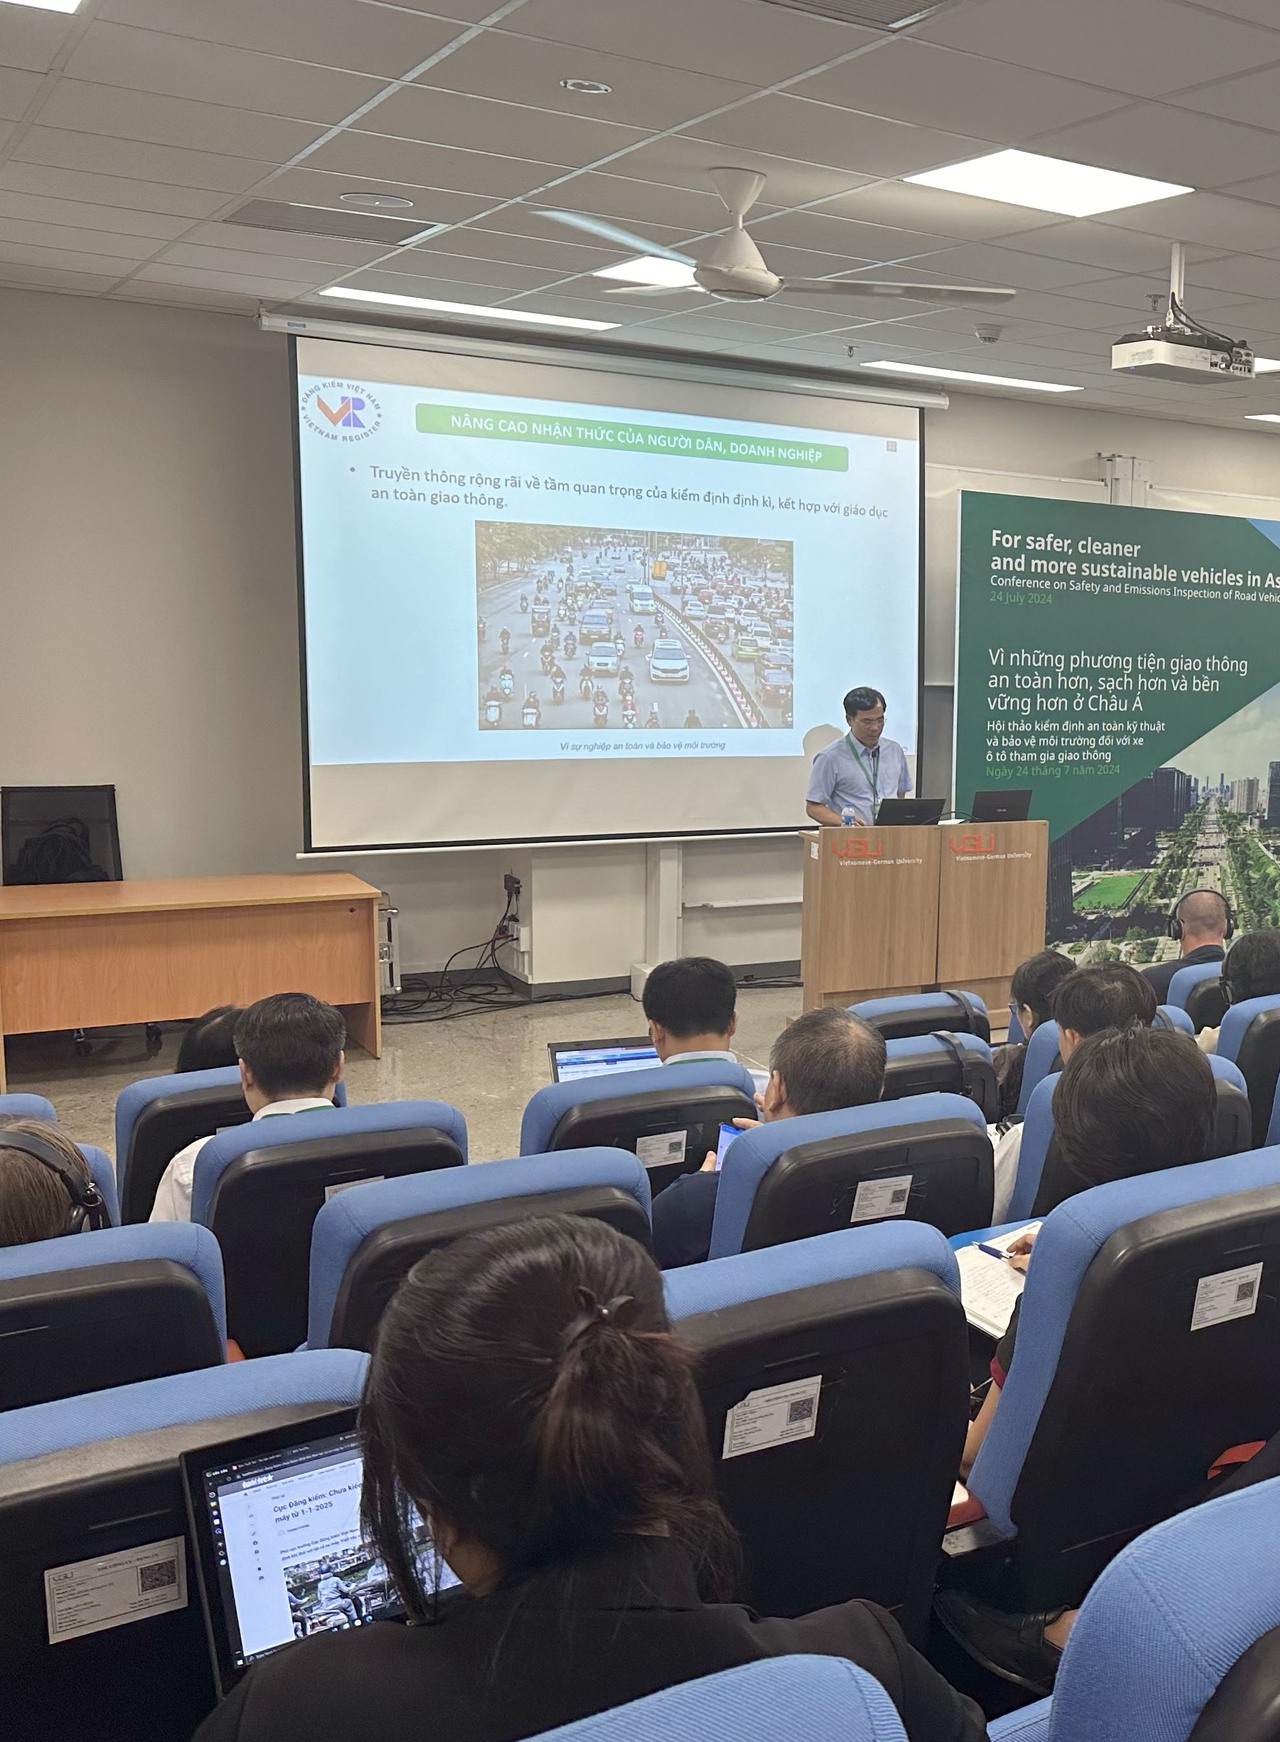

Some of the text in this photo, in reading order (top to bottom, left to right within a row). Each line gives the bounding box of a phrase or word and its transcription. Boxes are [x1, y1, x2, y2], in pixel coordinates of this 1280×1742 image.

[366, 393, 381, 410] NAM
[303, 414, 381, 442] VIETNAM REGISTER
[451, 413, 822, 464] NÂNG CAO NHẬN THỨC CỦA NGƯỜI DÂN, DOANH NGHIỆP
[370, 465, 420, 483] Truyền
[424, 469, 466, 487] thông
[470, 473, 501, 490] rộng
[505, 475, 521, 489] rãi
[525, 475, 541, 490] về
[544, 477, 570, 492] tầm
[573, 482, 606, 496] quan
[609, 484, 643, 501] trọng
[646, 485, 668, 500] của
[671, 486, 700, 503] kiểm
[703, 491, 730, 507] định
[733, 493, 759, 508] định
[778, 496, 796, 510] kết
[798, 498, 821, 514] hợp
[824, 501, 841, 515] với
[843, 503, 866, 518] giáo
[869, 505, 889, 520] dục
[371, 487, 508, 511] an toàn giao thông.
[992, 529, 1141, 558] For safer, cleaner
[991, 554, 1026, 572] and
[1031, 558, 1077, 575] more
[1081, 561, 1177, 582] sustainable
[1181, 567, 1243, 587] vehicles
[1247, 570, 1261, 588] in
[990, 575, 1051, 589] Conference
[1054, 581, 1067, 590] on
[1069, 580, 1101, 595] Safety
[1103, 583, 1122, 594] and
[1124, 583, 1171, 597] Emissions
[1173, 586, 1221, 600] Inspection
[1223, 589, 1233, 600] of
[1234, 590, 1257, 602] Road
[990, 590, 1052, 605] 24 July 2024
[989, 648, 1248, 676] Vì những phương tiện giao thông
[988, 671, 1219, 693] an toàn hơn, sạch hơn và bền
[987, 691, 1143, 715] vững hơn ở Châu Á
[987, 719, 1165, 734] Hội thảo kiểm định an toàn kỹ thuật
[986, 734, 1144, 749] và bảo vệ môi trường đối với xe
[986, 749, 1111, 764] ô tô tham gia giao thông
[986, 764, 1120, 780] Ngày 24 tháng 7 năm 2024
[301, 1501, 333, 1515] 1-1-2025
